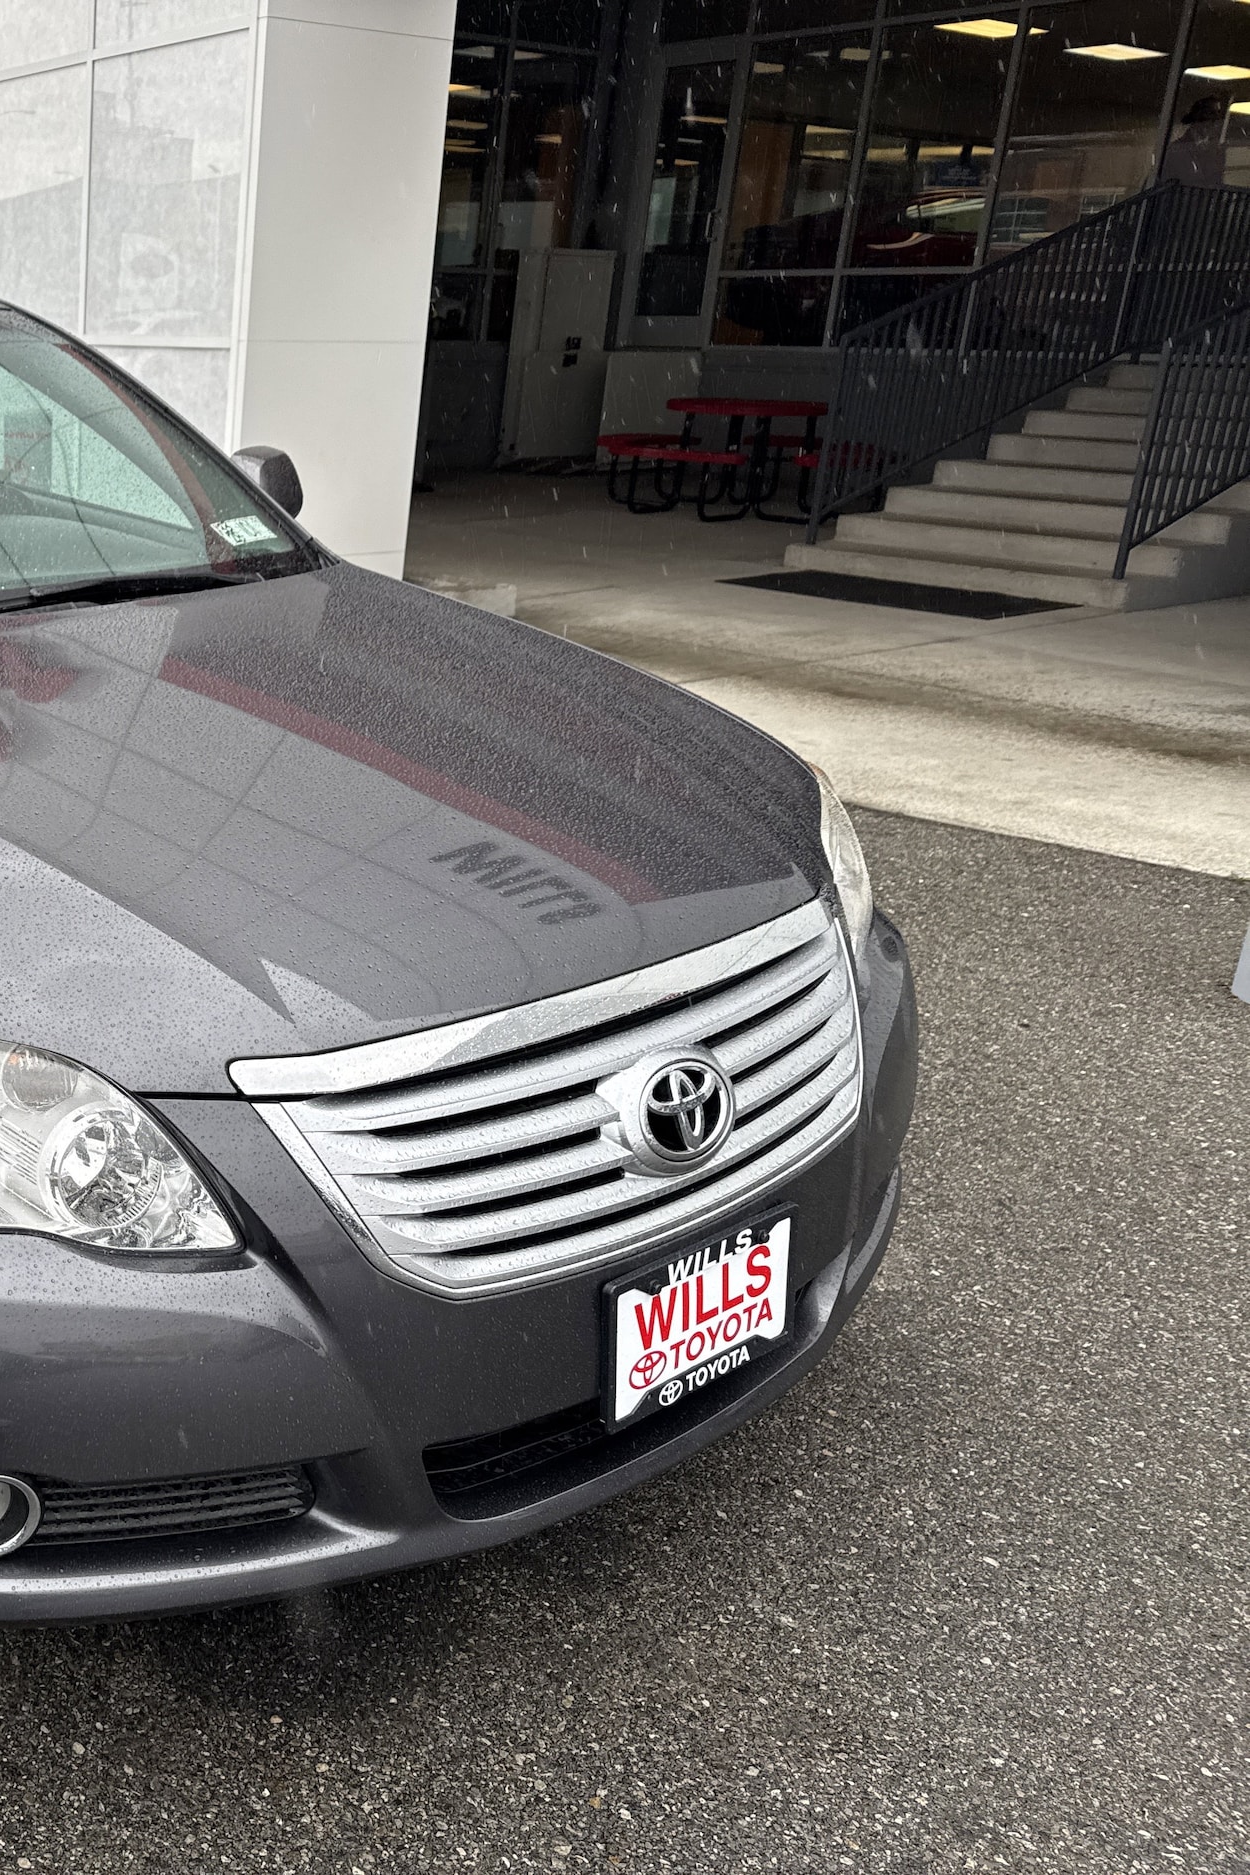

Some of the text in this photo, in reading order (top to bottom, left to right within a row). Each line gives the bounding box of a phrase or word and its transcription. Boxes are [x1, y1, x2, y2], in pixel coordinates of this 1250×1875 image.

[667, 1229, 753, 1285] WILLS
[634, 1245, 772, 1350] WILLS
[670, 1297, 773, 1369] TOYOTA
[685, 1345, 751, 1391] TOYOTA
